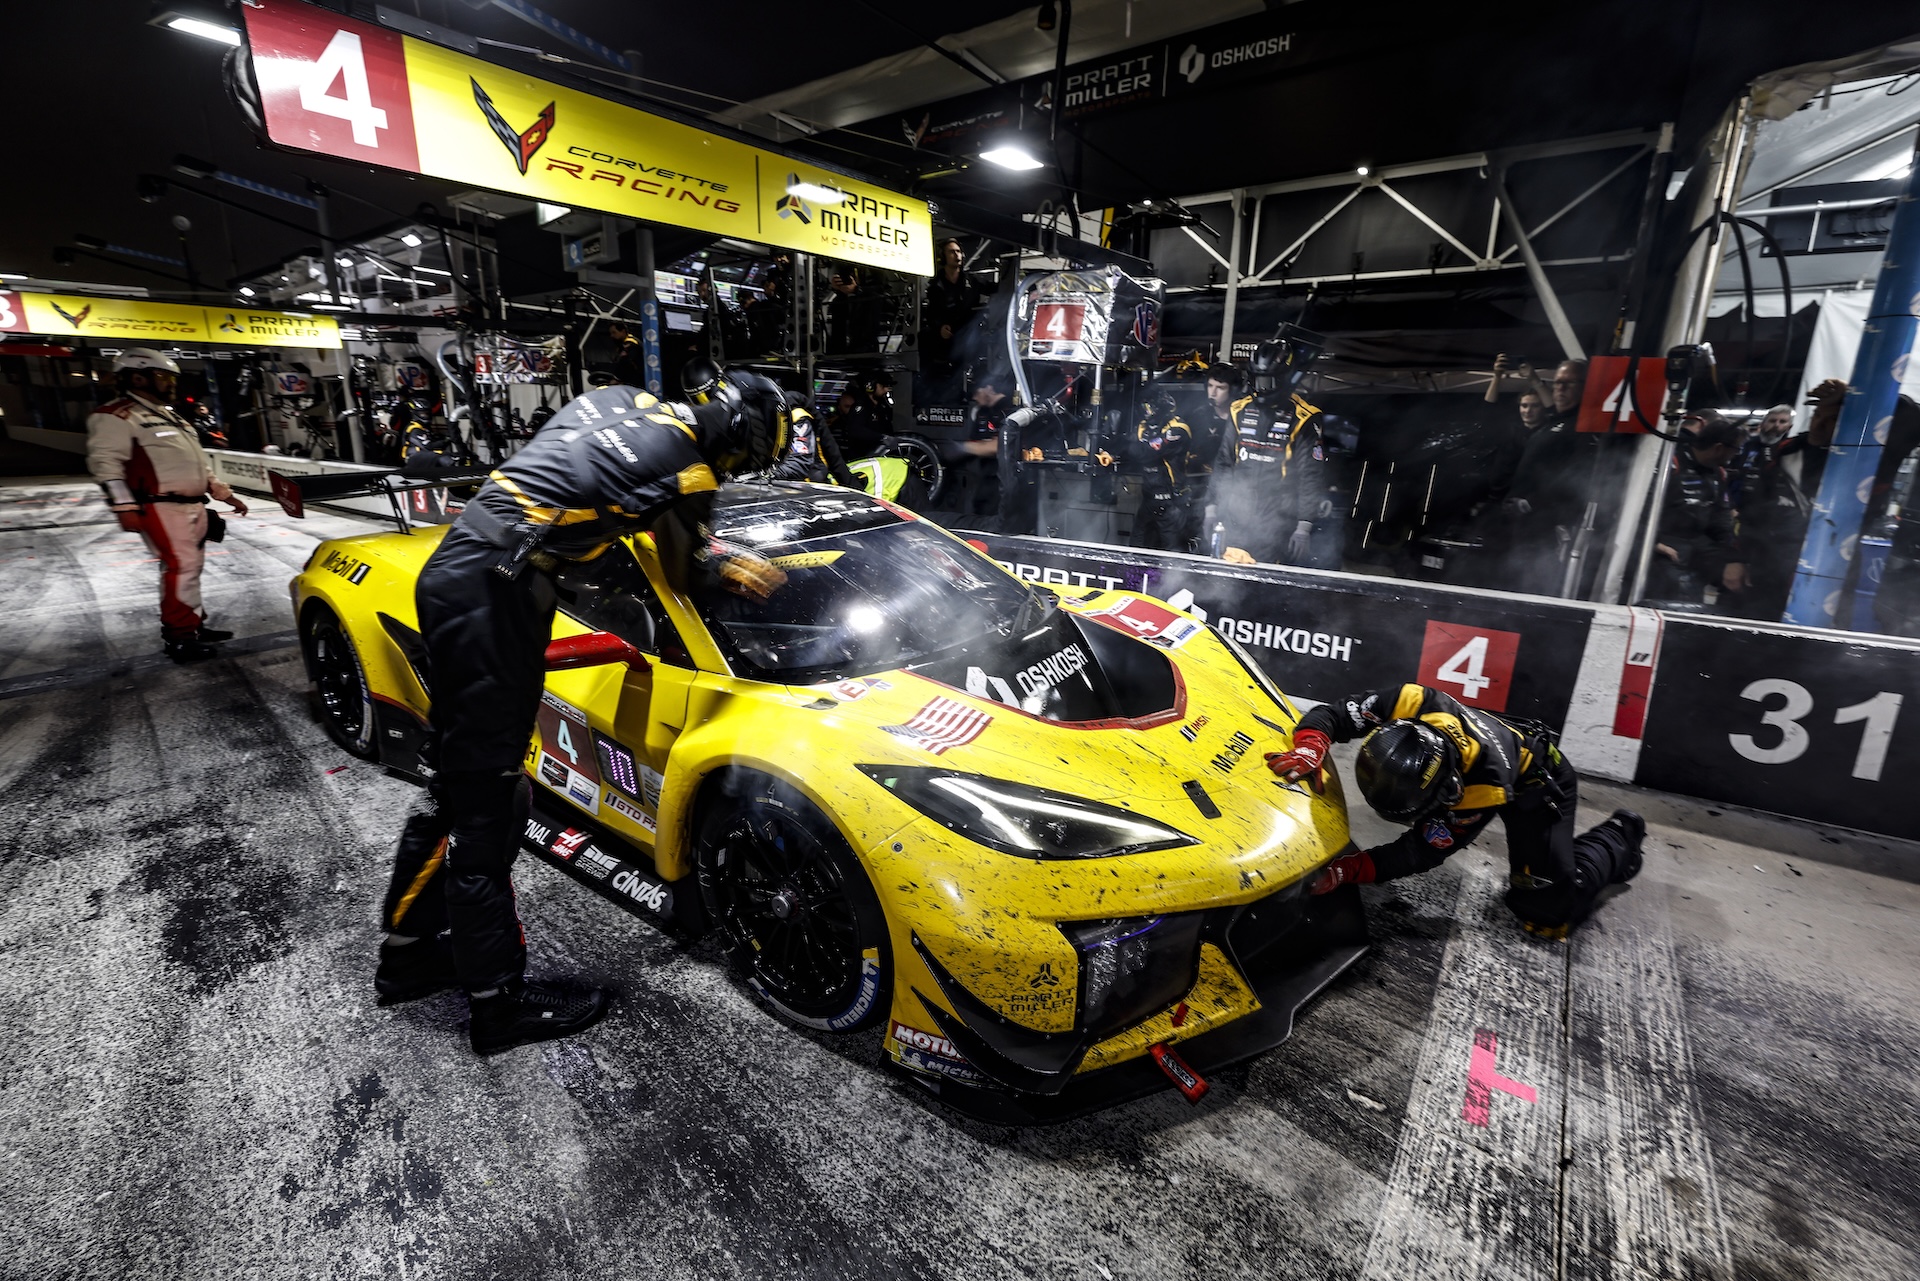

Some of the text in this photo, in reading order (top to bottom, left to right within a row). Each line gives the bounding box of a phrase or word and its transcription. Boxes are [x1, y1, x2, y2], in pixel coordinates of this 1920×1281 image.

[1211, 34, 1290, 69] OSHKOSH
[1066, 55, 1153, 91] PRATT
[301, 29, 388, 148] 4
[1065, 73, 1152, 107] MILLER
[567, 145, 729, 193] CORVETTE
[545, 157, 741, 214] RACING
[820, 208, 910, 248] MILLER
[821, 235, 911, 262] MOTORSPORTS
[88, 321, 197, 333] RACING
[98, 316, 188, 327] CORVETTE
[248, 315, 319, 328] PRATT
[250, 325, 319, 338] MILLER
[1046, 307, 1066, 336] 4
[101, 348, 233, 360] PSCHE
[478, 355, 487, 373] 3
[929, 407, 964, 415] PRATT
[1602, 371, 1639, 422] 4
[929, 414, 963, 422] MILLER
[414, 489, 427, 511] 3
[320, 550, 371, 585] Mobil 1
[1118, 614, 1160, 632] 4
[1218, 617, 1352, 662] OSHKOSH
[1015, 643, 1088, 698] OSHKOSH
[1436, 636, 1490, 699] 4
[1190, 715, 1211, 732] IMSA
[1728, 678, 1904, 782] 31
[557, 719, 578, 765] 4
[1210, 736, 1249, 773] Mobil
[616, 800, 641, 822] GTD
[574, 860, 608, 881] GATEWAY
[831, 976, 876, 1030] MICHELIN
[1009, 988, 1076, 1003] PRATT
[1010, 996, 1075, 1013] MILLER
[895, 1024, 963, 1059] MOTU
[926, 1059, 984, 1080] MICH
